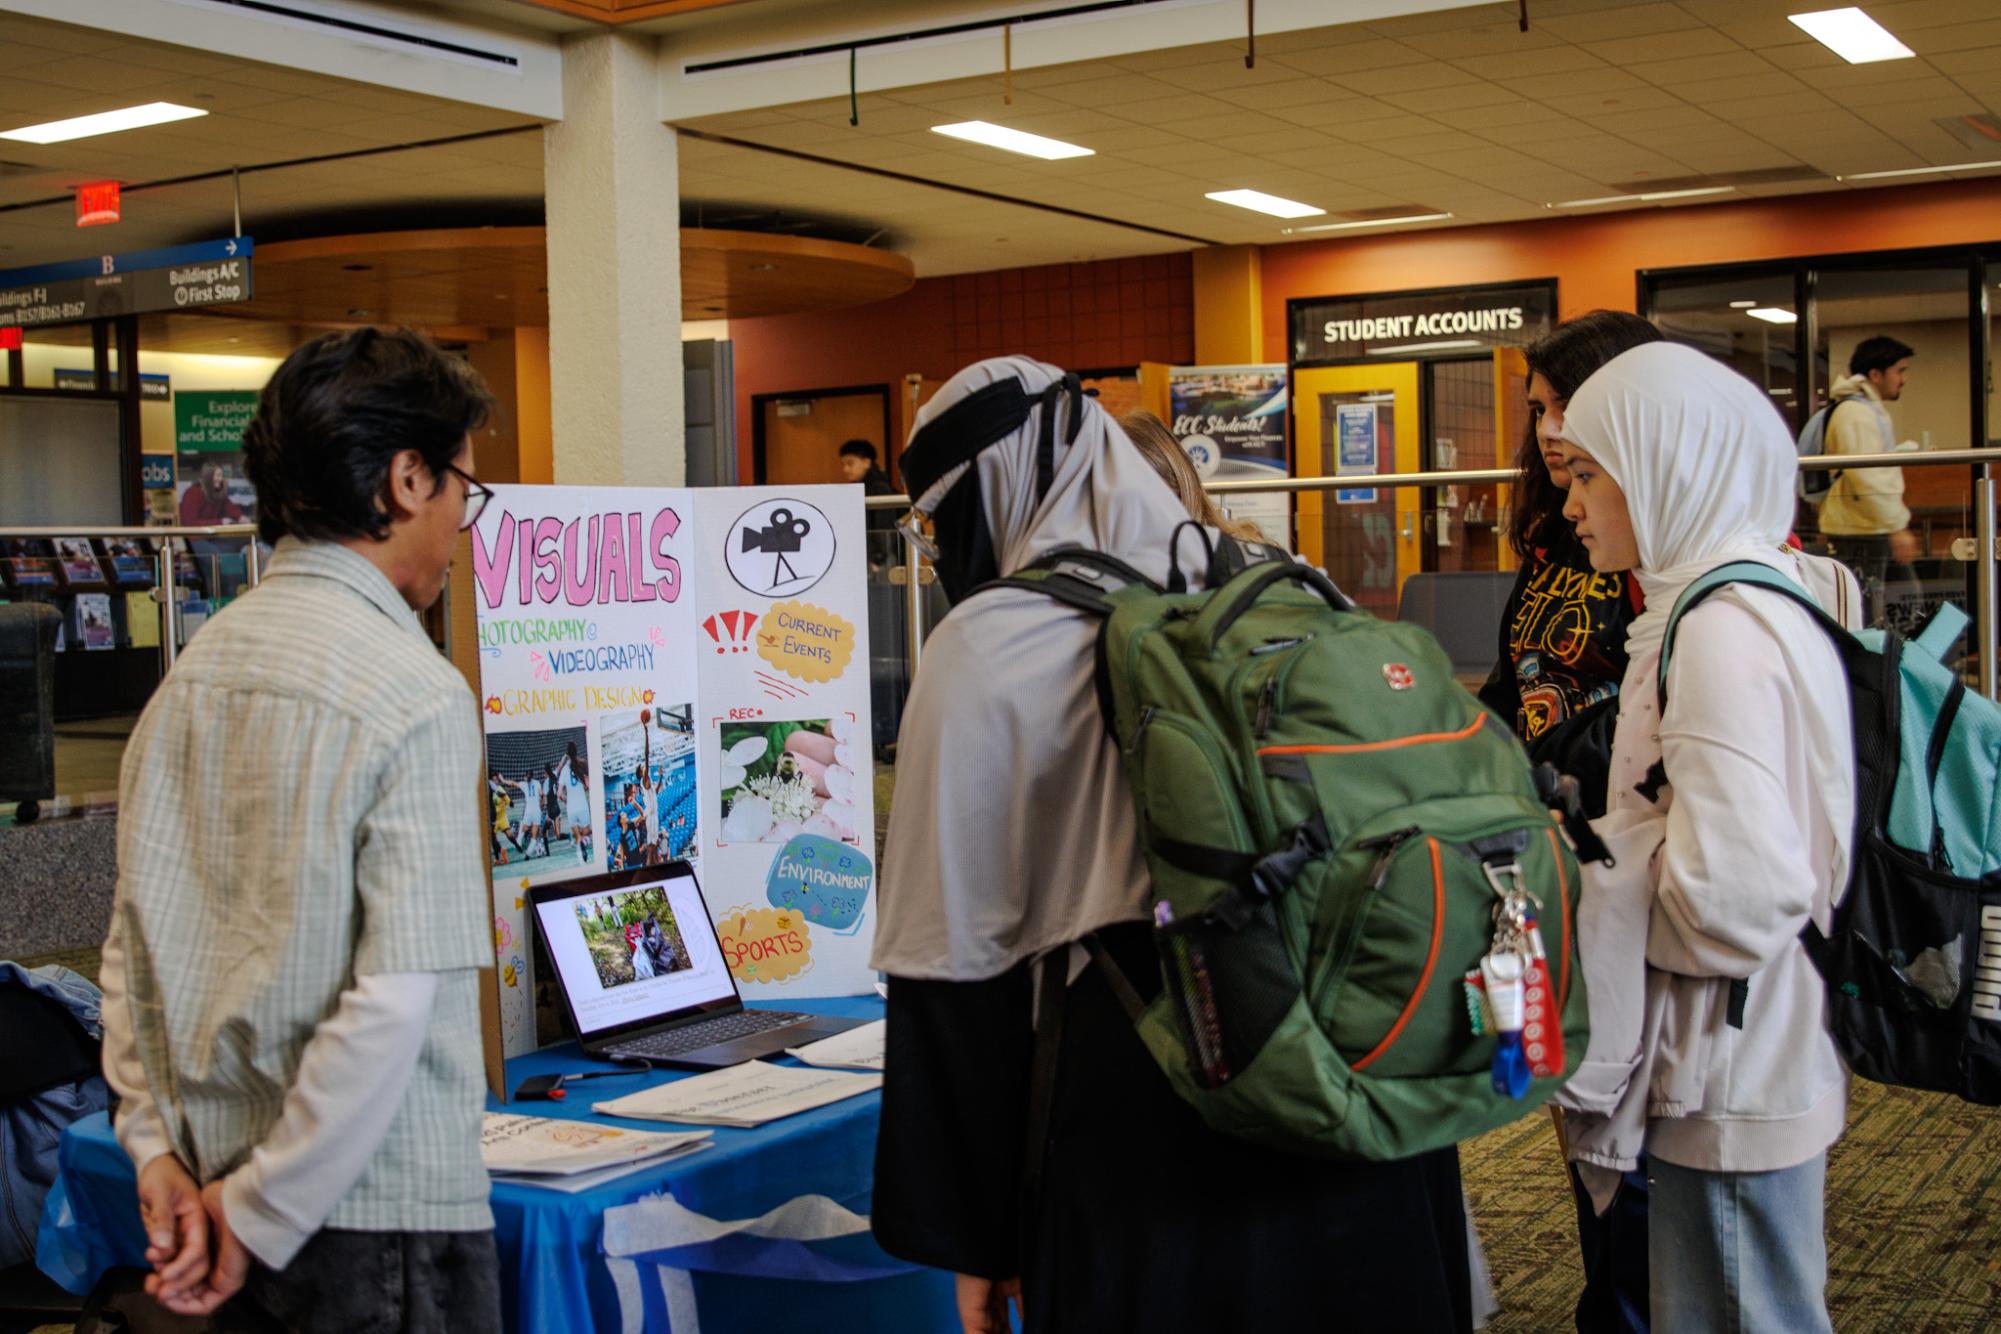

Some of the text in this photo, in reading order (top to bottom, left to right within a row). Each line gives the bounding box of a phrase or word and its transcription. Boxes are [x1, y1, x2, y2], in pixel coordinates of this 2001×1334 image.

[102, 255, 115, 275] B
[170, 267, 219, 286] Buildings
[189, 284, 240, 303] First Stop
[1324, 307, 1524, 343] STUDENT ACCOUNTS
[179, 428, 244, 443] and Scho
[1173, 414, 1268, 435] ECC Students!
[142, 461, 171, 482] obs
[470, 507, 682, 609] VISUALS
[480, 618, 587, 647] HOTOGRAPHY
[778, 612, 842, 642] CURRENT
[549, 644, 655, 675] VIDEOGRAPHY
[783, 635, 832, 664] EVENTS
[503, 684, 643, 717] GRAPHIC DESIGN
[729, 708, 754, 720] REC
[778, 855, 870, 891] ENVIRONMENT
[722, 930, 804, 970] SPORTS
